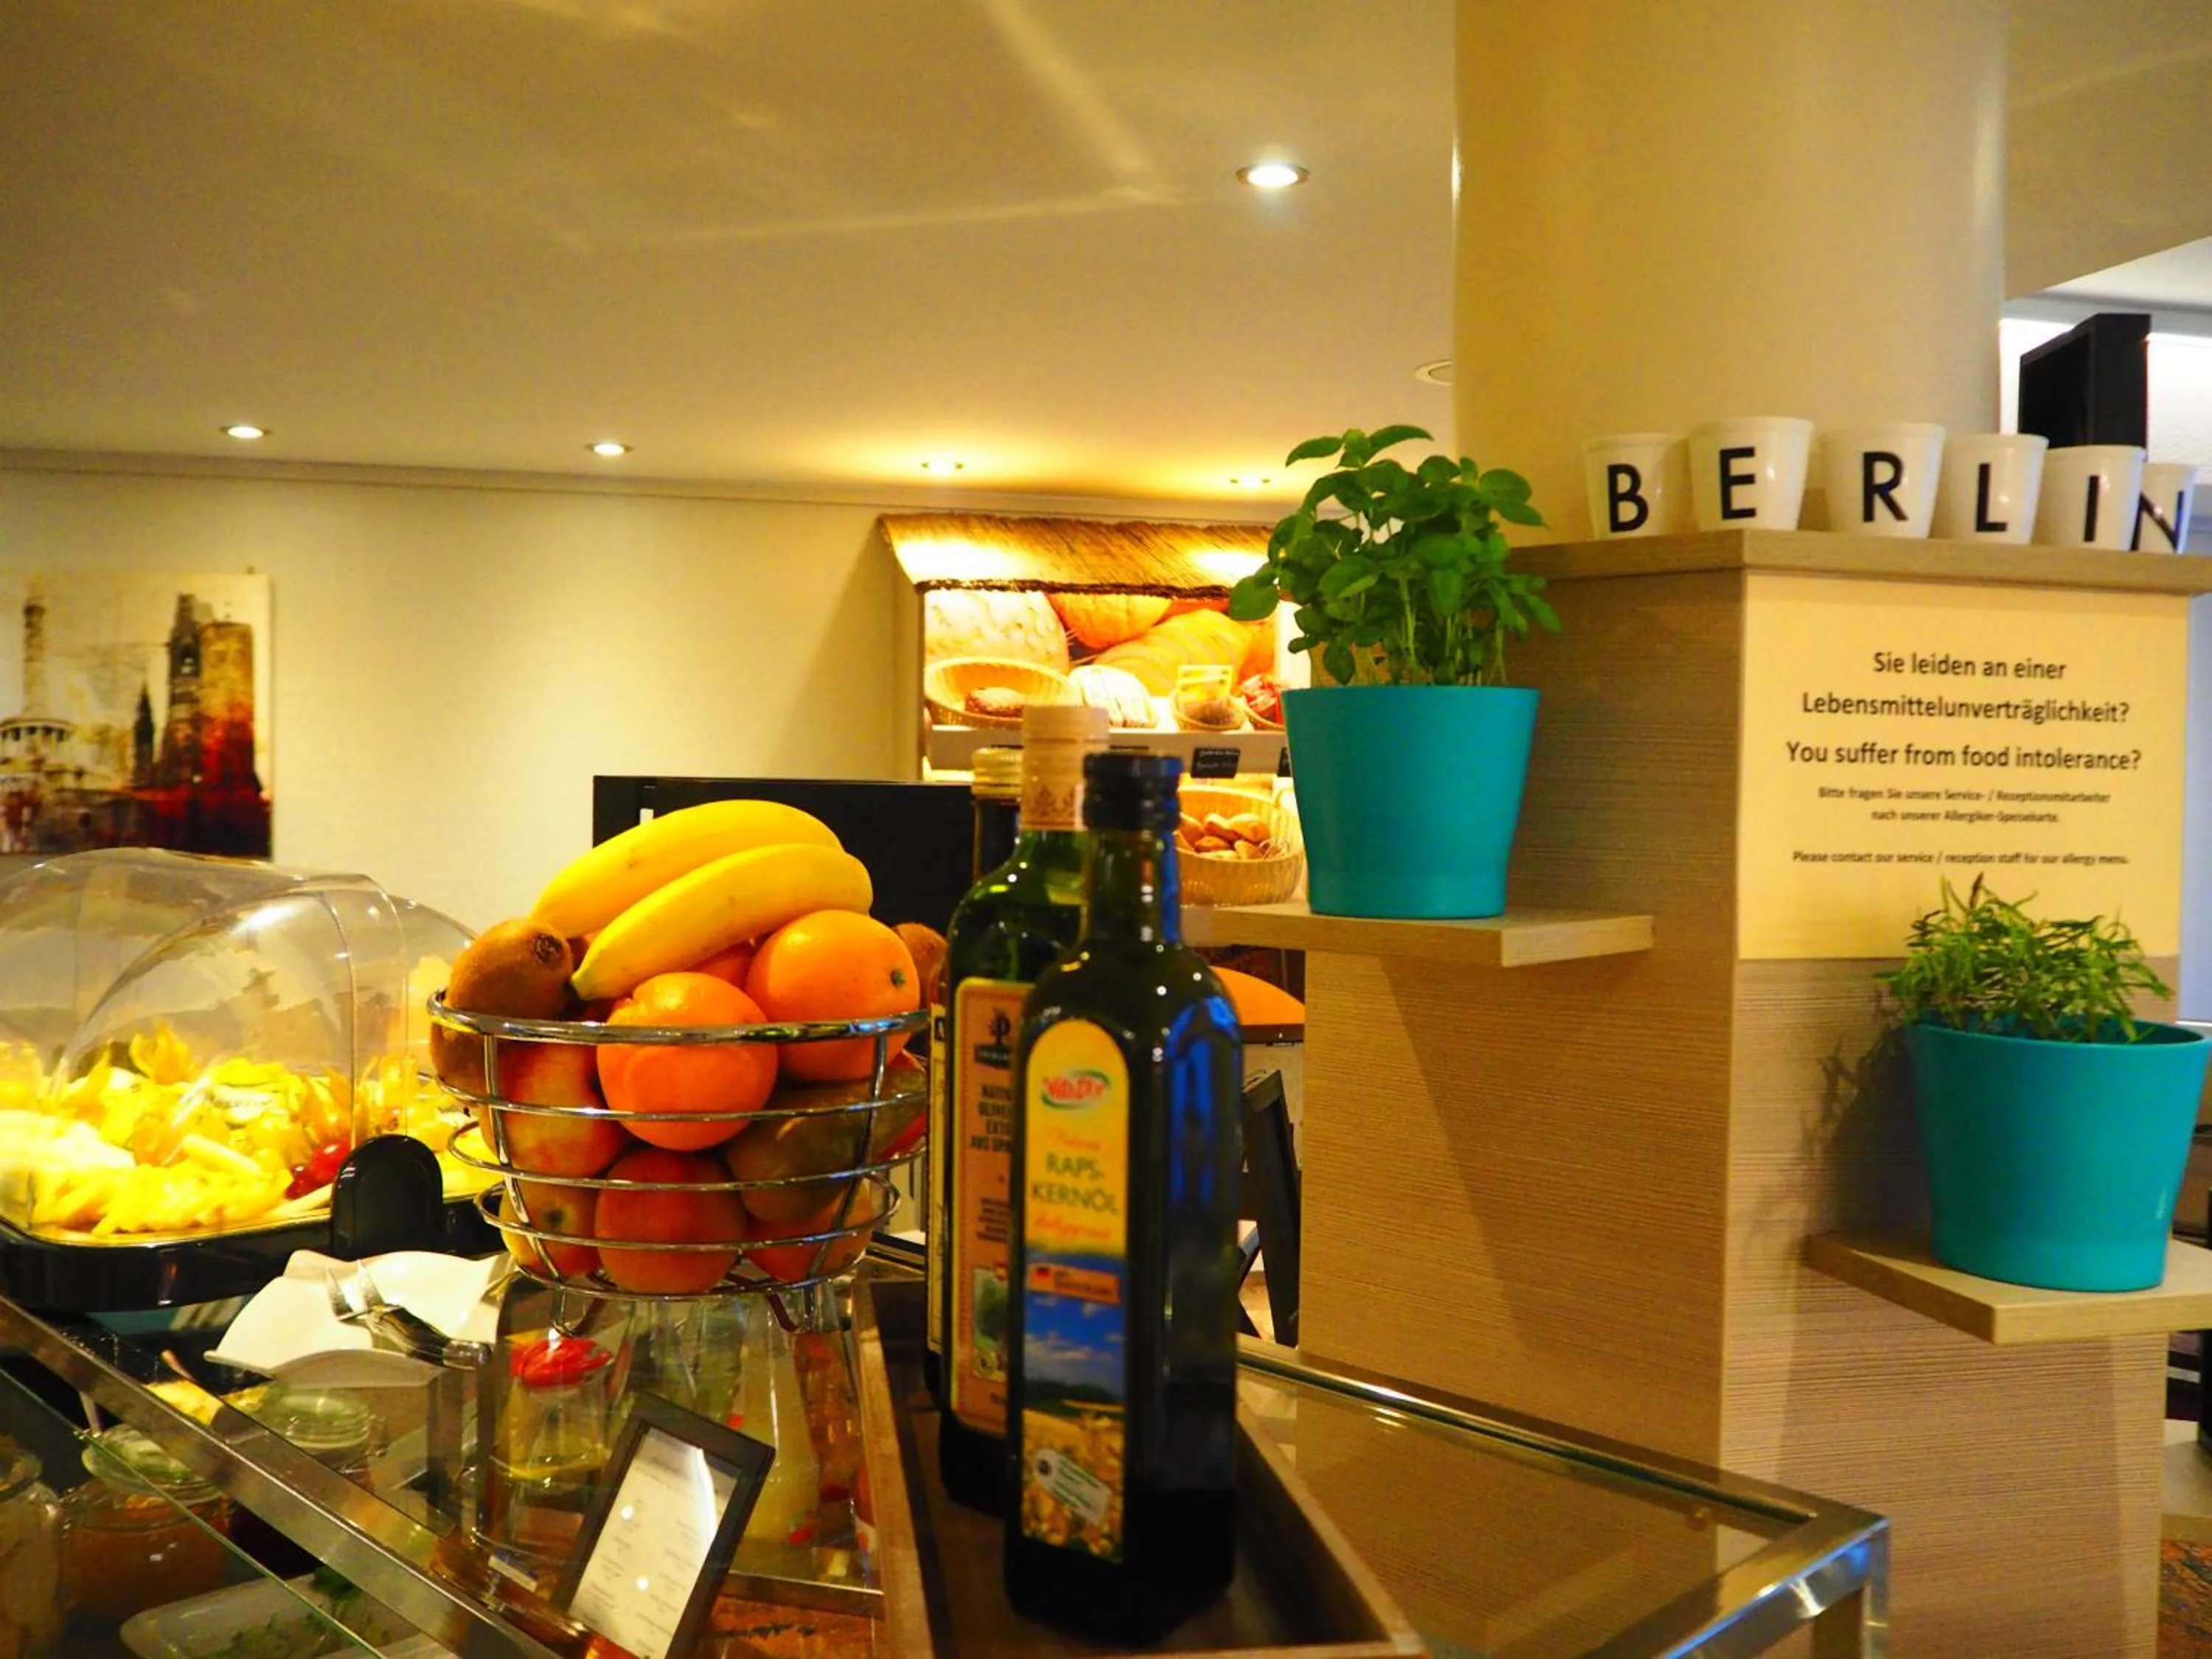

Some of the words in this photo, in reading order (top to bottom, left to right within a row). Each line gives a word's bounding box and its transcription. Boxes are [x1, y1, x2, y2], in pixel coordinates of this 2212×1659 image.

[1873, 651, 1905, 673] Sie
[1911, 652, 1976, 676] leiden
[1983, 661, 2008, 677] an
[2014, 657, 2067, 679] einer
[1802, 691, 2130, 726] Lebensmittelunverträglichkeit?
[1786, 741, 1828, 763] You
[1834, 742, 1899, 765] suffer
[1904, 743, 1956, 766] from
[1961, 745, 2010, 767] food
[2016, 746, 2142, 771] intolerance?
[1818, 786, 1845, 799] Bitte
[1848, 787, 1884, 801] fragen
[1887, 787, 1903, 799] Sie
[1905, 790, 1941, 800] unsere
[1871, 809, 1898, 821] nach
[1900, 811, 1941, 821] unserer
[1792, 851, 1829, 863] Please
[1831, 852, 1874, 863] contact
[1875, 853, 1893, 863] our
[1896, 853, 1934, 863] service
[1944, 853, 1994, 865] reception
[1997, 852, 2022, 864] staff
[2024, 852, 2039, 864] for
[2041, 855, 2059, 864] our
[2062, 853, 2096, 866] allergy
